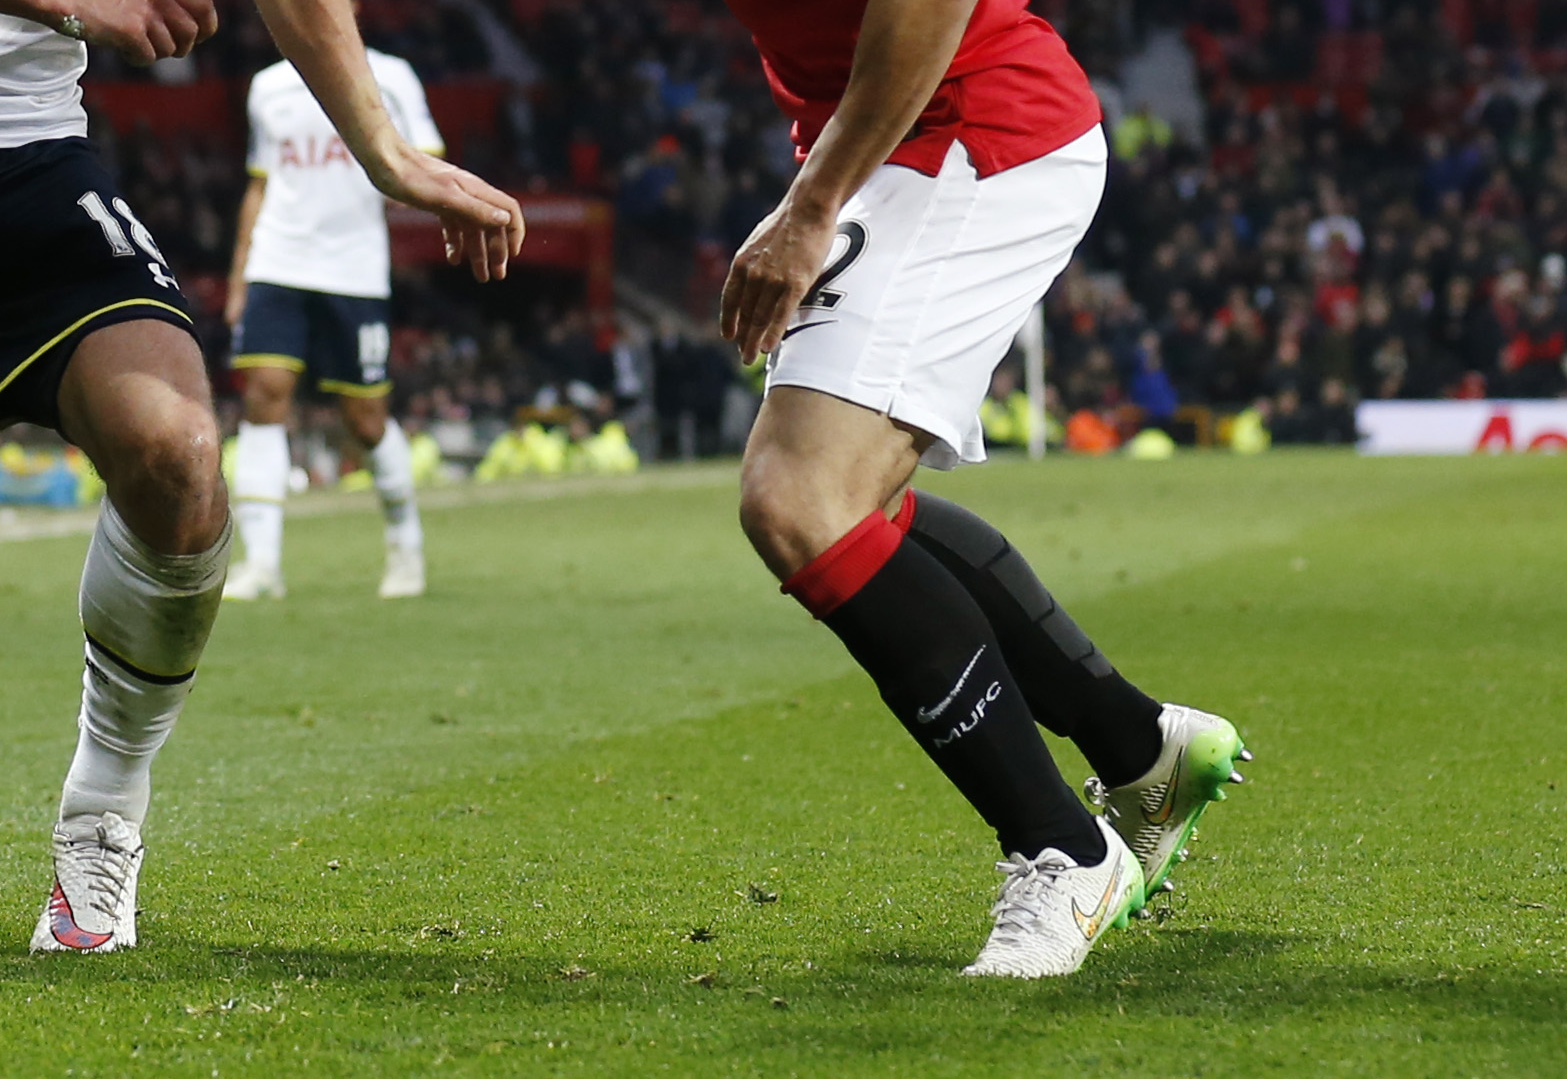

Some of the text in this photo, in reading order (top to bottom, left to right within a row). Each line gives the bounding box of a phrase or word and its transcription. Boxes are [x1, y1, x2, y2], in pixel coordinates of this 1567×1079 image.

[280, 134, 353, 168] AIA
[797, 217, 871, 312] 2
[933, 680, 1002, 749] MUFC
